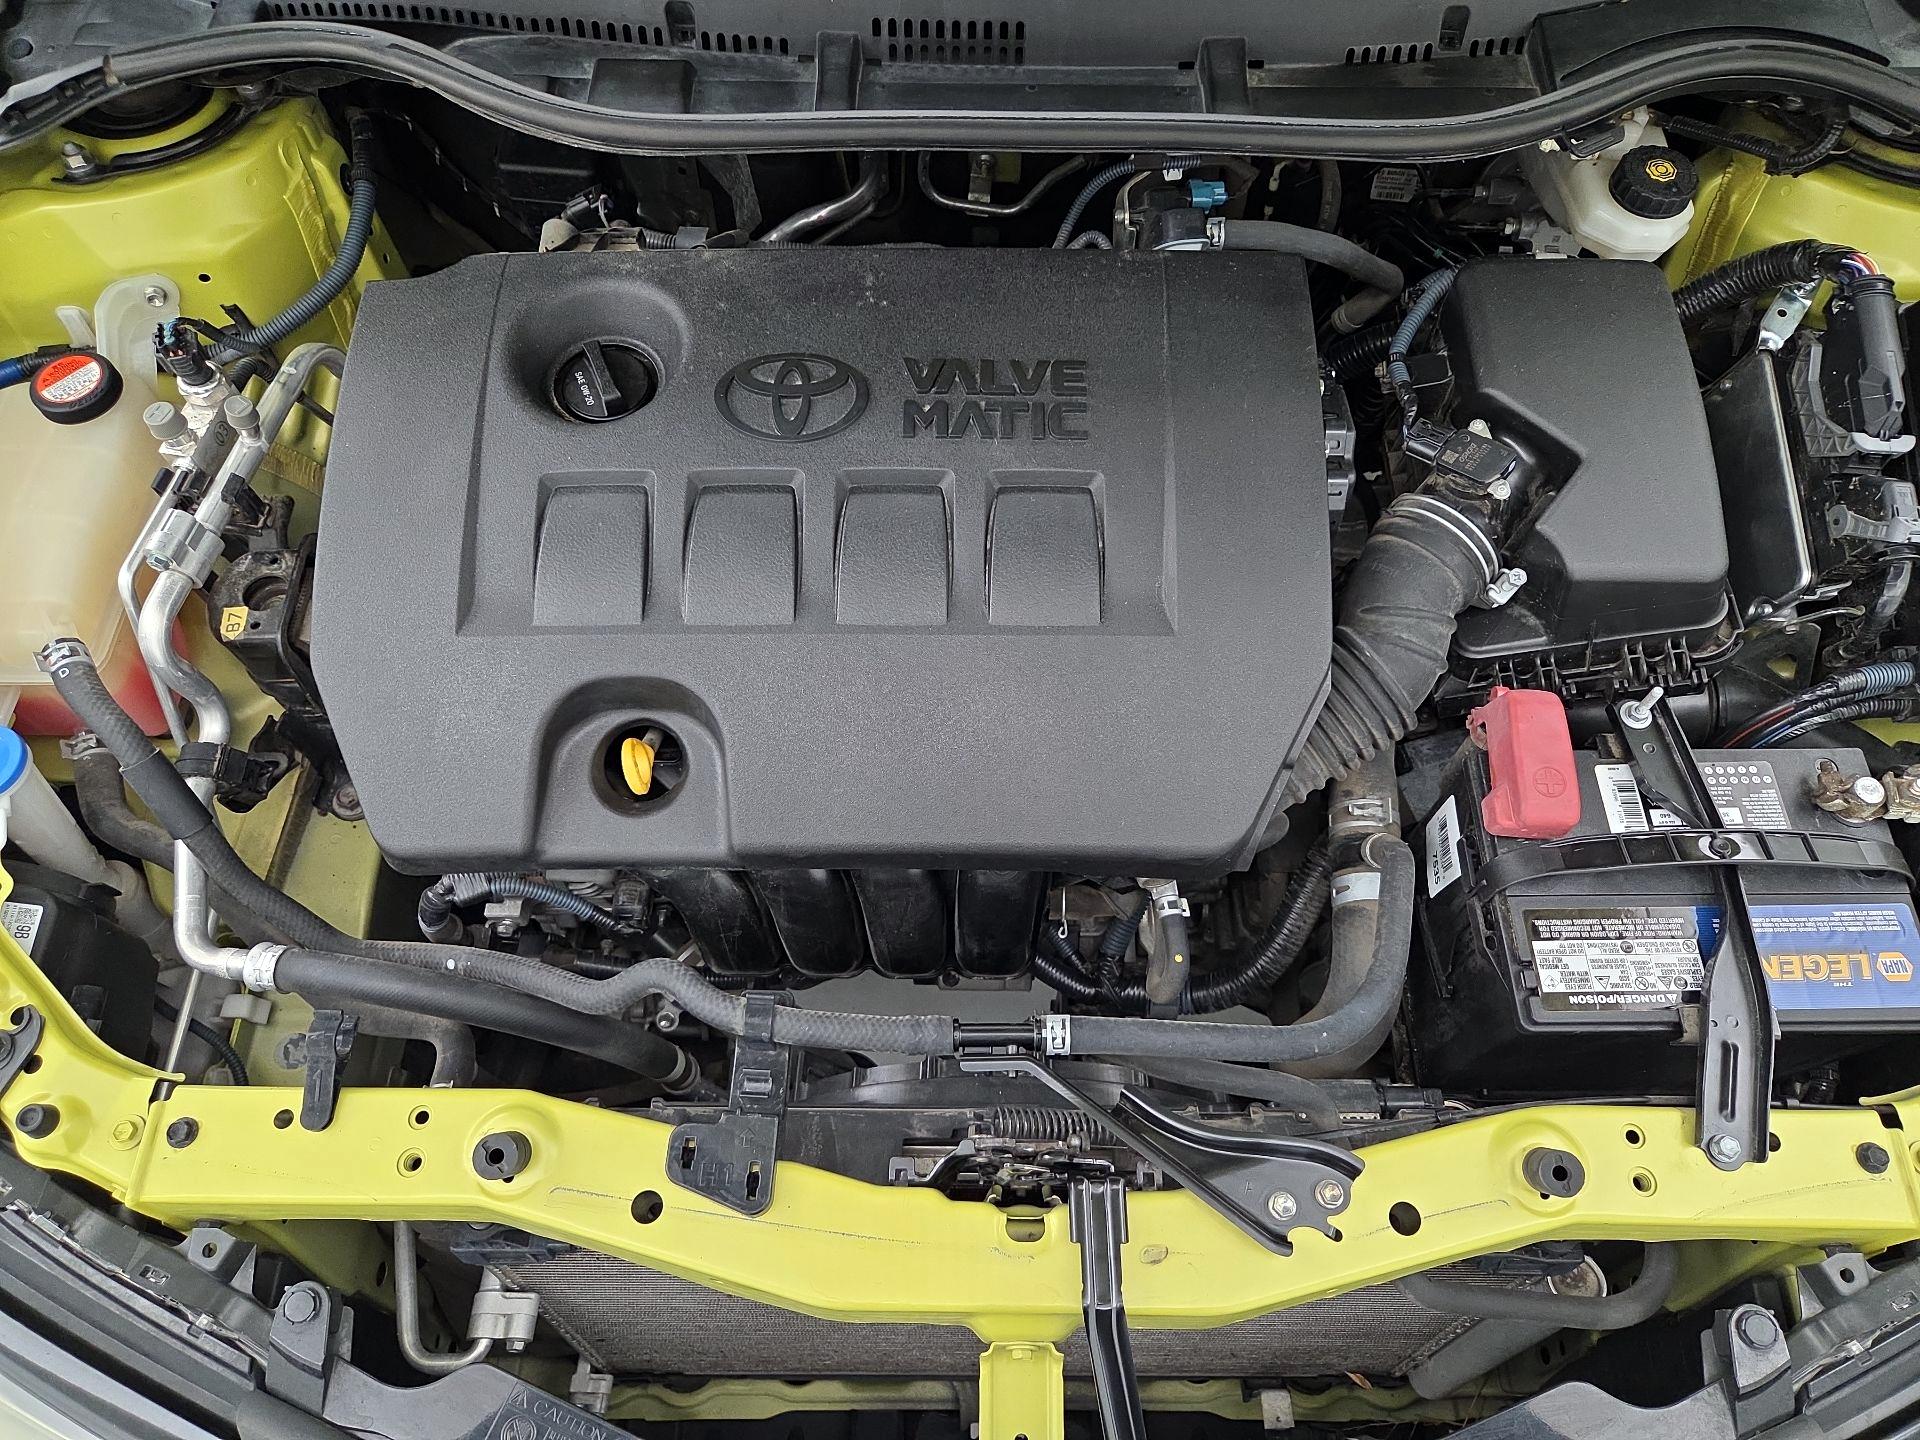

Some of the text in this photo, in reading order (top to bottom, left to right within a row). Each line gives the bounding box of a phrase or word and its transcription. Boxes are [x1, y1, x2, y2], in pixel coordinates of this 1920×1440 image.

[575, 372, 595, 406] SAE 0W-20
[903, 357, 1087, 398] VALVE
[902, 400, 1088, 440] MATIC
[226, 612, 242, 632] B7
[14, 924, 32, 939] 9B
[1761, 953, 1872, 981] LEGEN
[1881, 960, 1908, 973] NAPA
[1568, 994, 1666, 1004] DANGER/POISON
[534, 1400, 606, 1440] CAUTION
